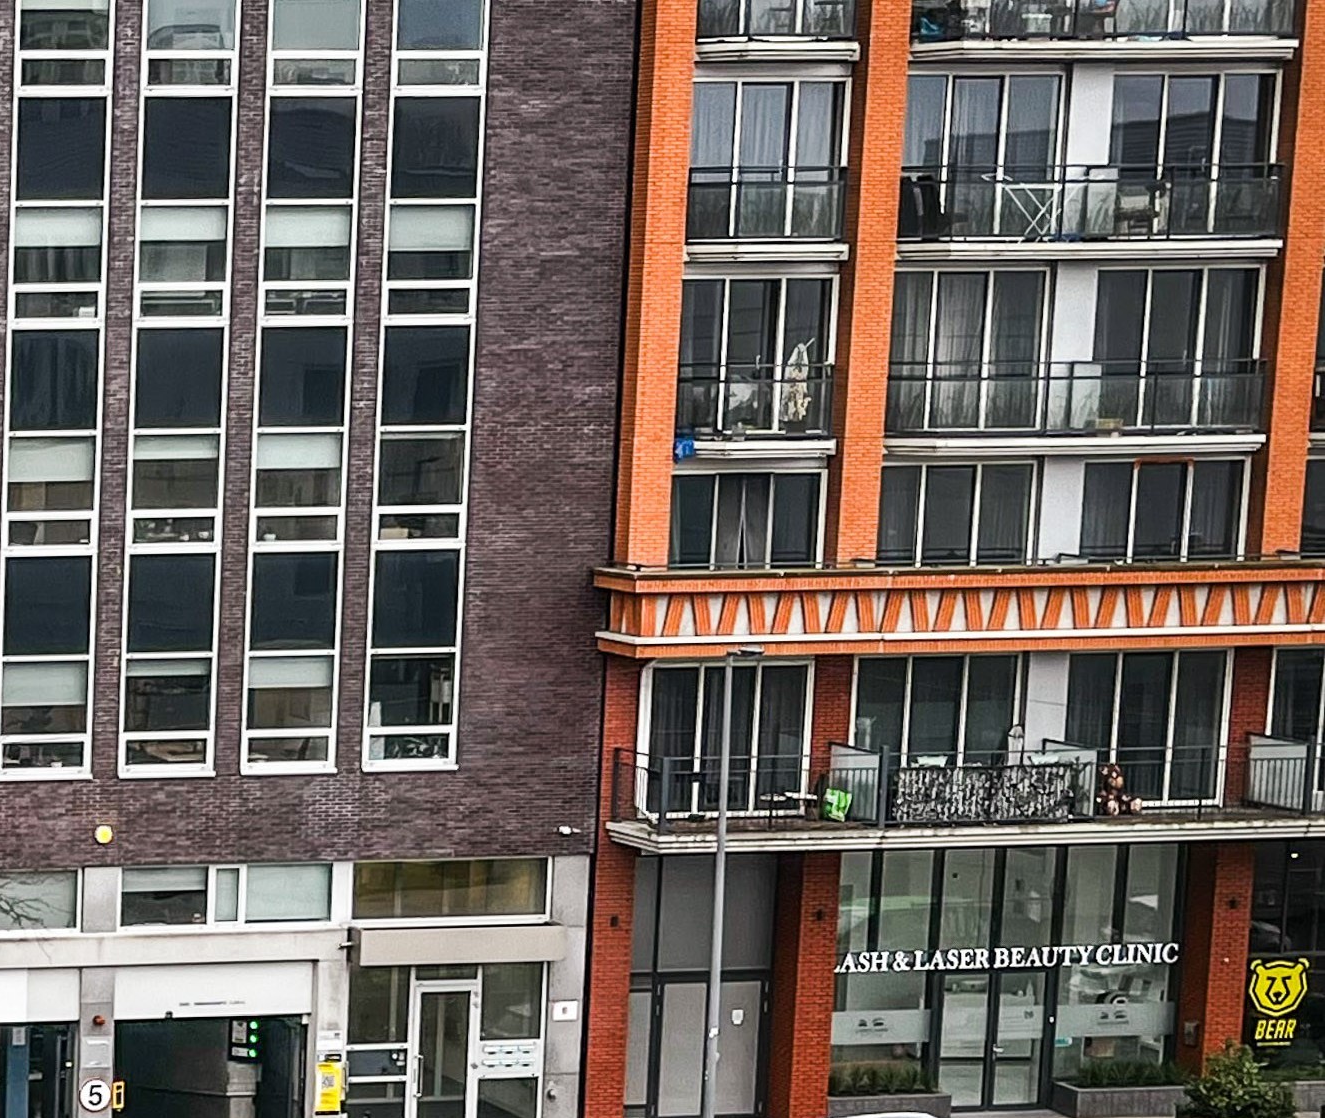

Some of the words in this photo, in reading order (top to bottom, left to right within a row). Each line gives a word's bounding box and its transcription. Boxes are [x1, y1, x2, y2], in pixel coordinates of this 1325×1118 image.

[892, 951, 911, 972] &
[913, 947, 990, 970] LASER
[993, 944, 1095, 969] BEAUTY
[1095, 942, 1180, 965] CLINIC
[1254, 1019, 1297, 1040] BEAR
[87, 1084, 103, 1107] 5
